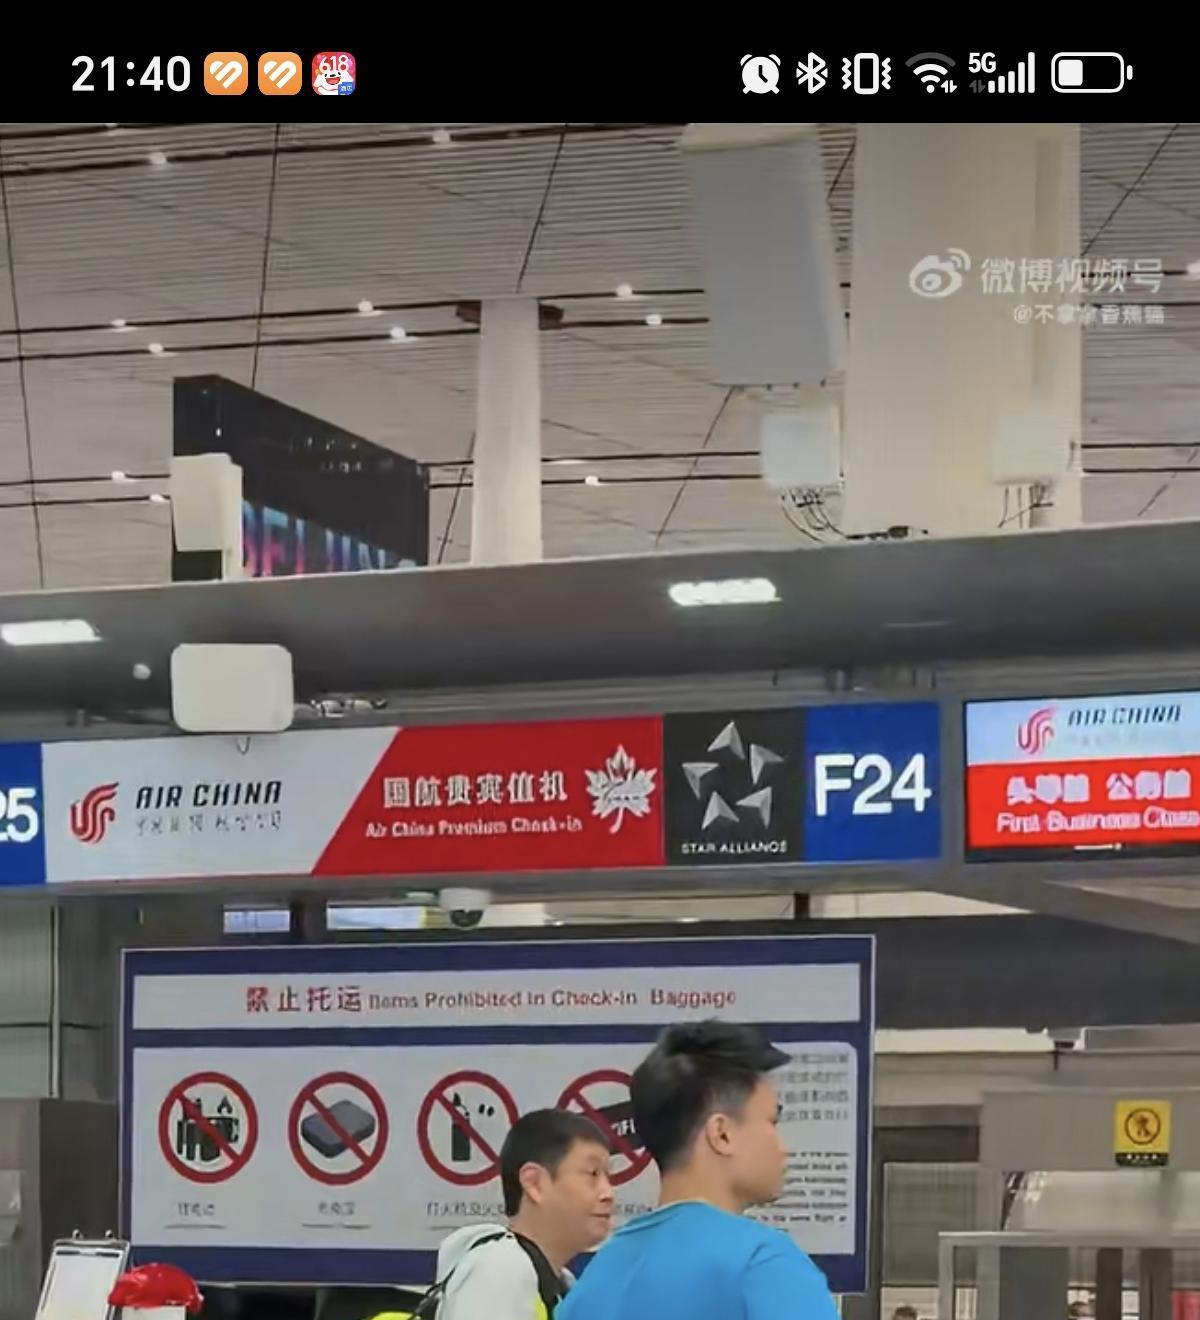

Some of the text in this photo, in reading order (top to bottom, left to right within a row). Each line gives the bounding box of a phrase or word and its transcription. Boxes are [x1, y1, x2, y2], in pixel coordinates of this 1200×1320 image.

[1111, 703, 1182, 725] CHINA
[136, 780, 282, 809] AIR CHINA
[382, 770, 568, 808] 国航贵宾值机
[814, 752, 933, 816] F24
[0, 787, 39, 844] 5
[366, 813, 582, 838] Air China Premium Check-in
[681, 842, 716, 855] STAR
[246, 985, 363, 1013] 禁止托运
[425, 989, 522, 1009] Prohibited
[650, 987, 736, 1009] Baggage
